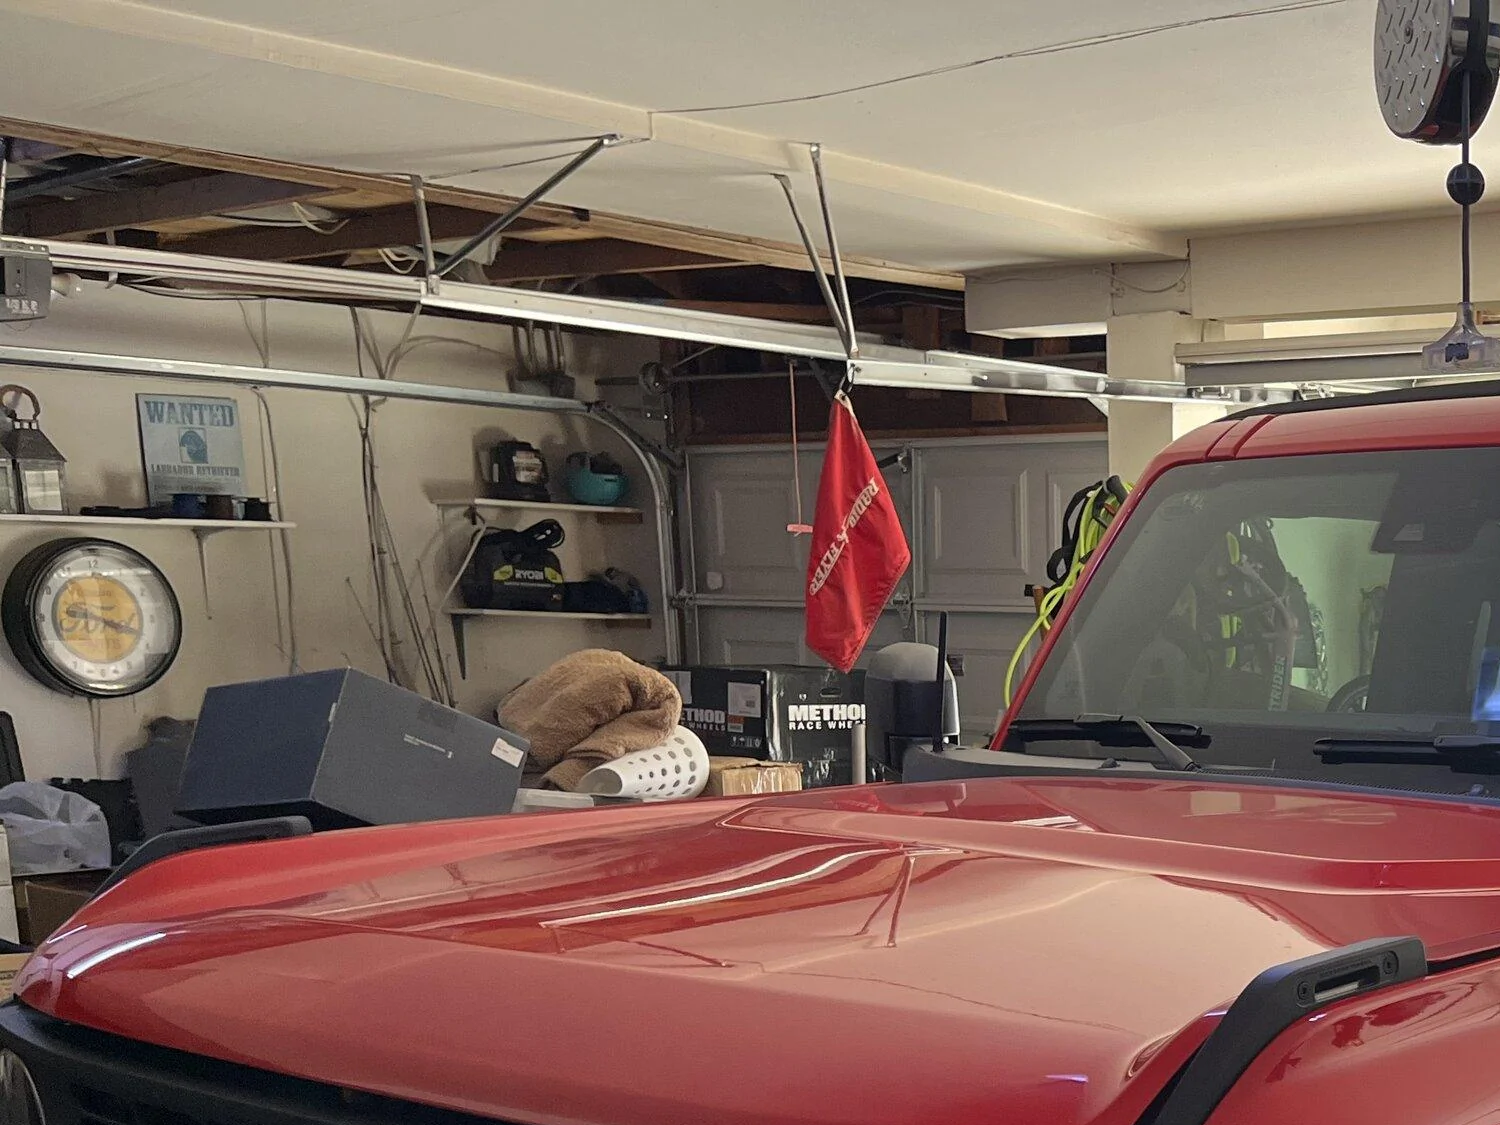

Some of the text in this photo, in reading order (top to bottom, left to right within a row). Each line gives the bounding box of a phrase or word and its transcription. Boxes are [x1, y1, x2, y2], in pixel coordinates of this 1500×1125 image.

[145, 401, 234, 427] WANTED
[151, 464, 240, 476] LABRADOR RETRIEVER
[515, 569, 544, 580] RYOBI
[809, 540, 841, 596] FLYER
[1268, 655, 1286, 711] TRIDER
[788, 720, 866, 730] RACE WHE
